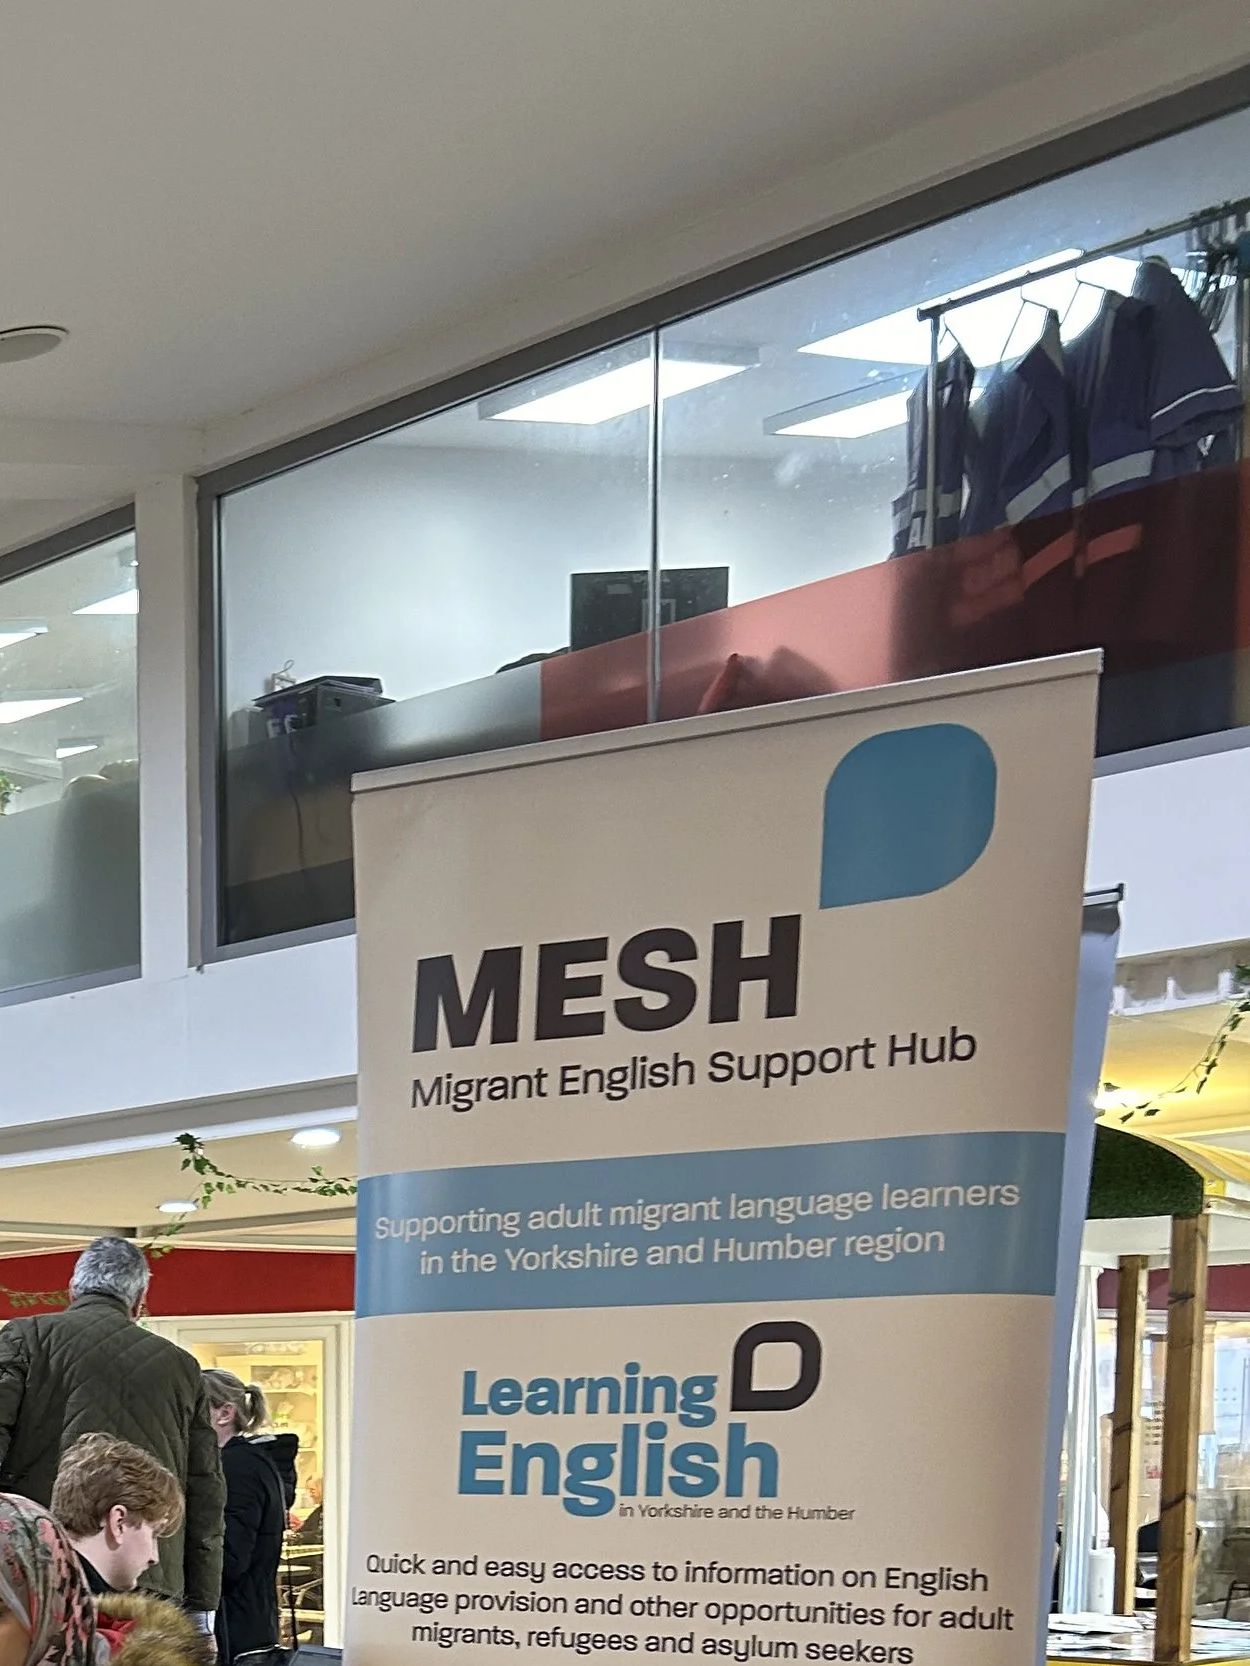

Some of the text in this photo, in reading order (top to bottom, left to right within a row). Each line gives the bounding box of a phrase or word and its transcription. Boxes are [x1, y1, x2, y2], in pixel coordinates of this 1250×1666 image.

[413, 914, 801, 1053] MESH
[412, 1026, 976, 1112] Migrant English Support Hub
[376, 1183, 1019, 1242] Supporting adult migrant language learners
[421, 1227, 944, 1274] in the Yorkshire and Humber region
[462, 1361, 718, 1428] Learning
[458, 1420, 779, 1517] English
[619, 1503, 855, 1520] in Yorkshire and the Humber
[367, 1553, 988, 1596] Quick and easy access to information on English
[352, 1587, 1014, 1630] Language provision and other opportunities for adult
[412, 1622, 913, 1664] migrants, refugees and asylum seekers
